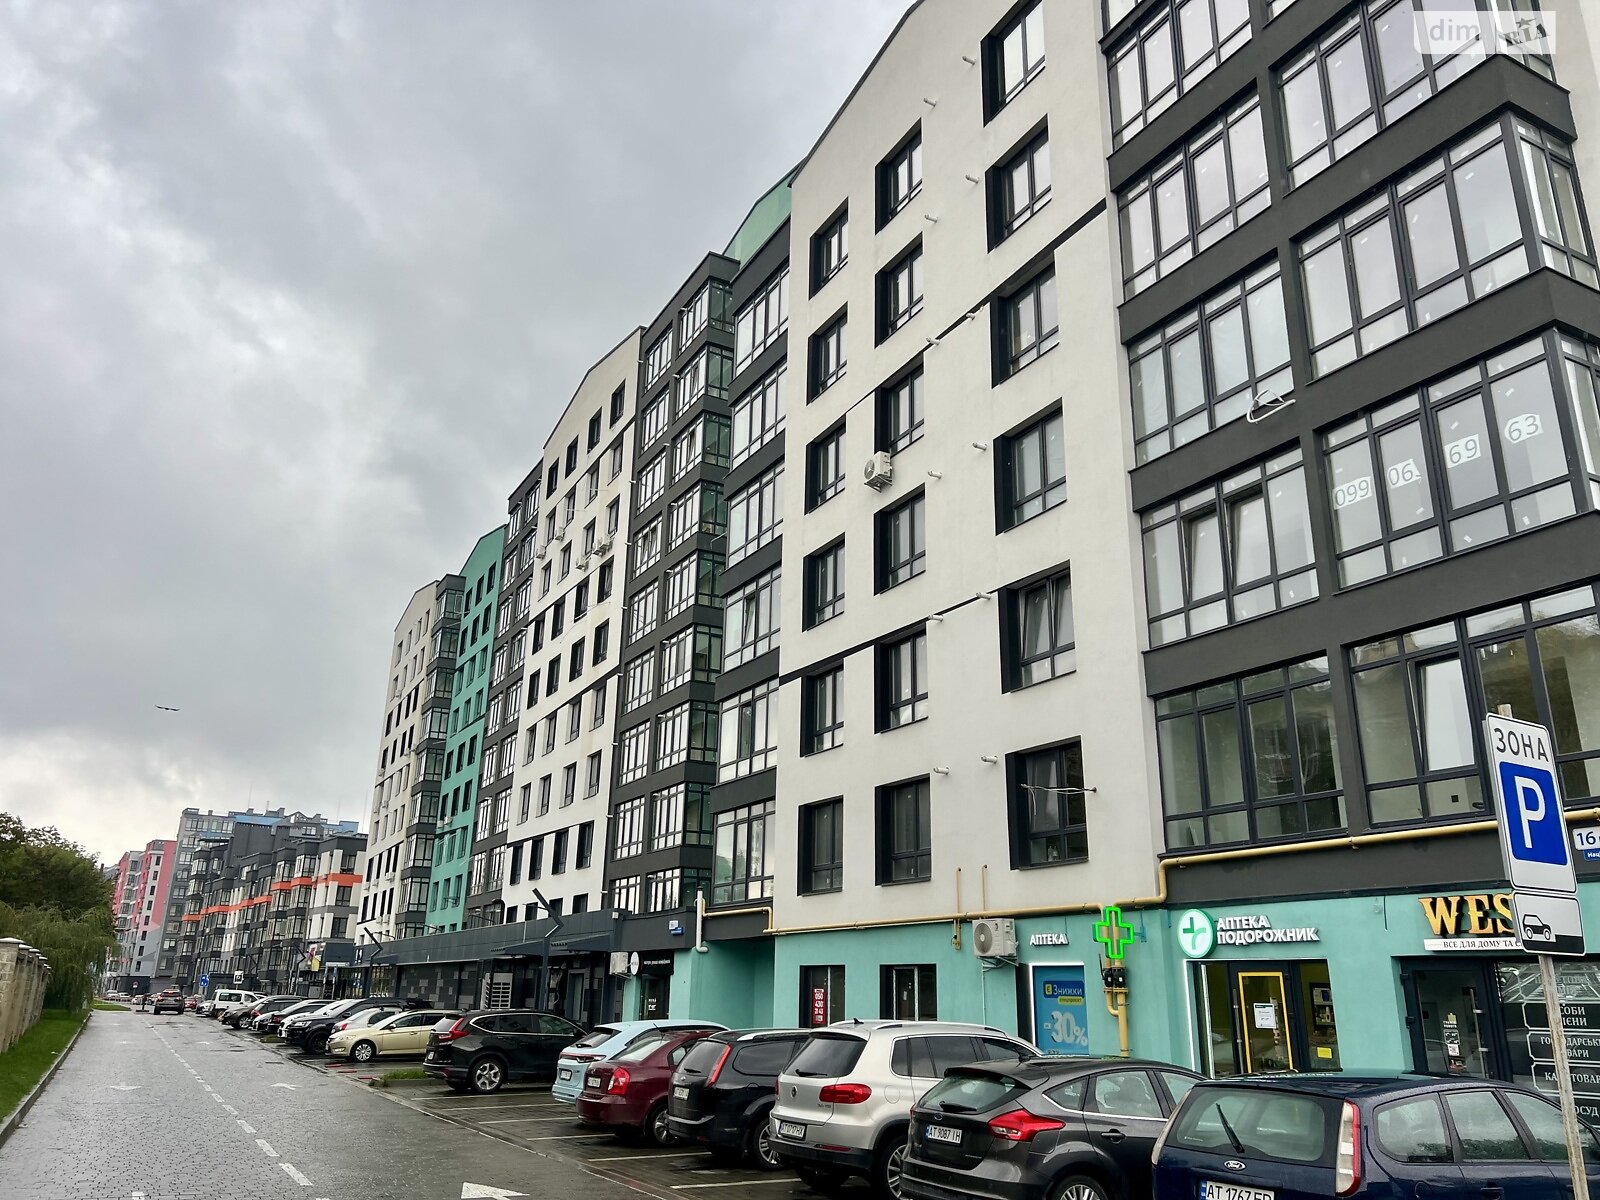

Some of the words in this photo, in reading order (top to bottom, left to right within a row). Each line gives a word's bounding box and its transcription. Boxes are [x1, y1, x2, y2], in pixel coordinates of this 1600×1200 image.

[1334, 479, 1370, 507] 099
[1388, 462, 1421, 486] 06
[1449, 438, 1478, 464] 69
[1508, 415, 1540, 442] 63
[1493, 727, 1549, 763] ЗОНА
[1514, 775, 1546, 849] P
[1576, 831, 1600, 846] 16
[1418, 892, 1516, 936] WES
[1216, 914, 1272, 931] АПТЕКА
[1029, 932, 1069, 946] АПТЕКА
[1216, 927, 1321, 946] ПОДОРОЖНИК
[1443, 941, 1458, 949] ВСЕ
[1459, 940, 1477, 949] ДЛЯ
[1477, 939, 1501, 949] ДОМУ
[1503, 939, 1514, 948] ТА
[1562, 1017, 1587, 1026] ІЄНИ
[1567, 1048, 1590, 1058] ВАРИ
[1574, 1105, 1599, 1118] ОСУД
[928, 1126, 937, 1137] AT
[1207, 1184, 1223, 1200] AT
[1225, 1187, 1251, 1200] 1767
